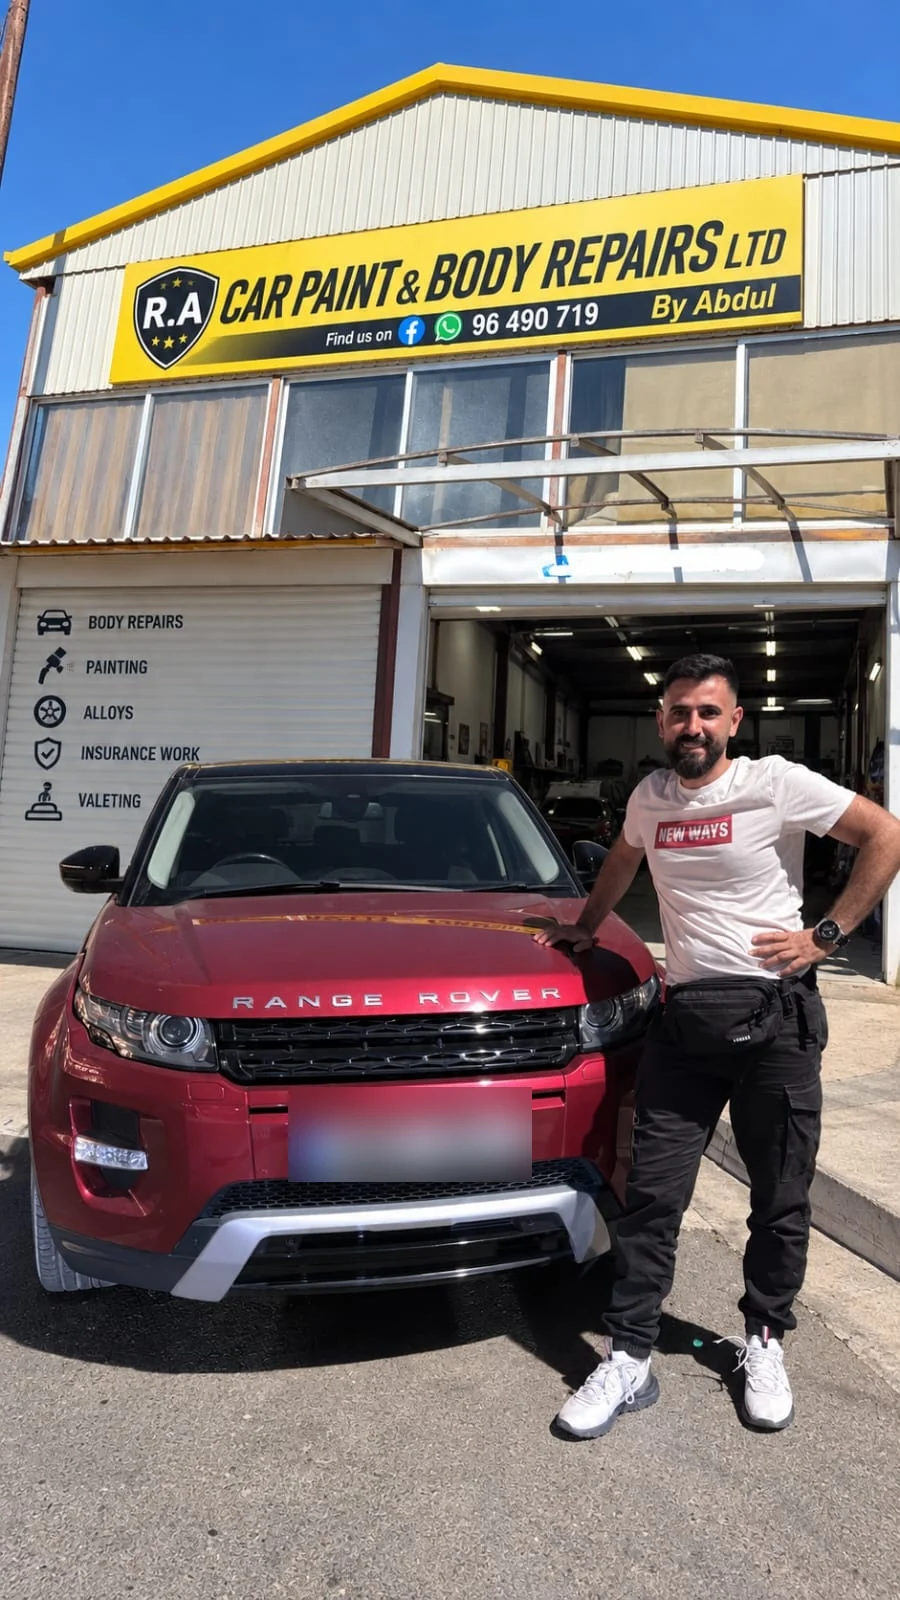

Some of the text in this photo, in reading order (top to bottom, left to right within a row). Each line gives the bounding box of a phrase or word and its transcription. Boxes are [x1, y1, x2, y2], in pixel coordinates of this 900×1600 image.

[220, 220, 787, 324] CAR PAINT & BODY REPAIRS LTD
[143, 292, 203, 329] R.A
[651, 282, 777, 324] By Abdul
[325, 329, 354, 347] Find
[356, 331, 373, 344] us
[375, 329, 393, 342] on
[472, 312, 499, 337] 96
[505, 306, 548, 333] 490
[556, 302, 599, 329] 719
[88, 615, 184, 629] BODY REPAIRS
[86, 660, 148, 675] PAINTING
[83, 705, 134, 720] ALLOYS
[81, 746, 200, 761] INSURANCE WORK
[78, 793, 141, 808] VALETING
[658, 822, 728, 842] NEW WAYS
[232, 987, 562, 1009] RANGE ROVER
